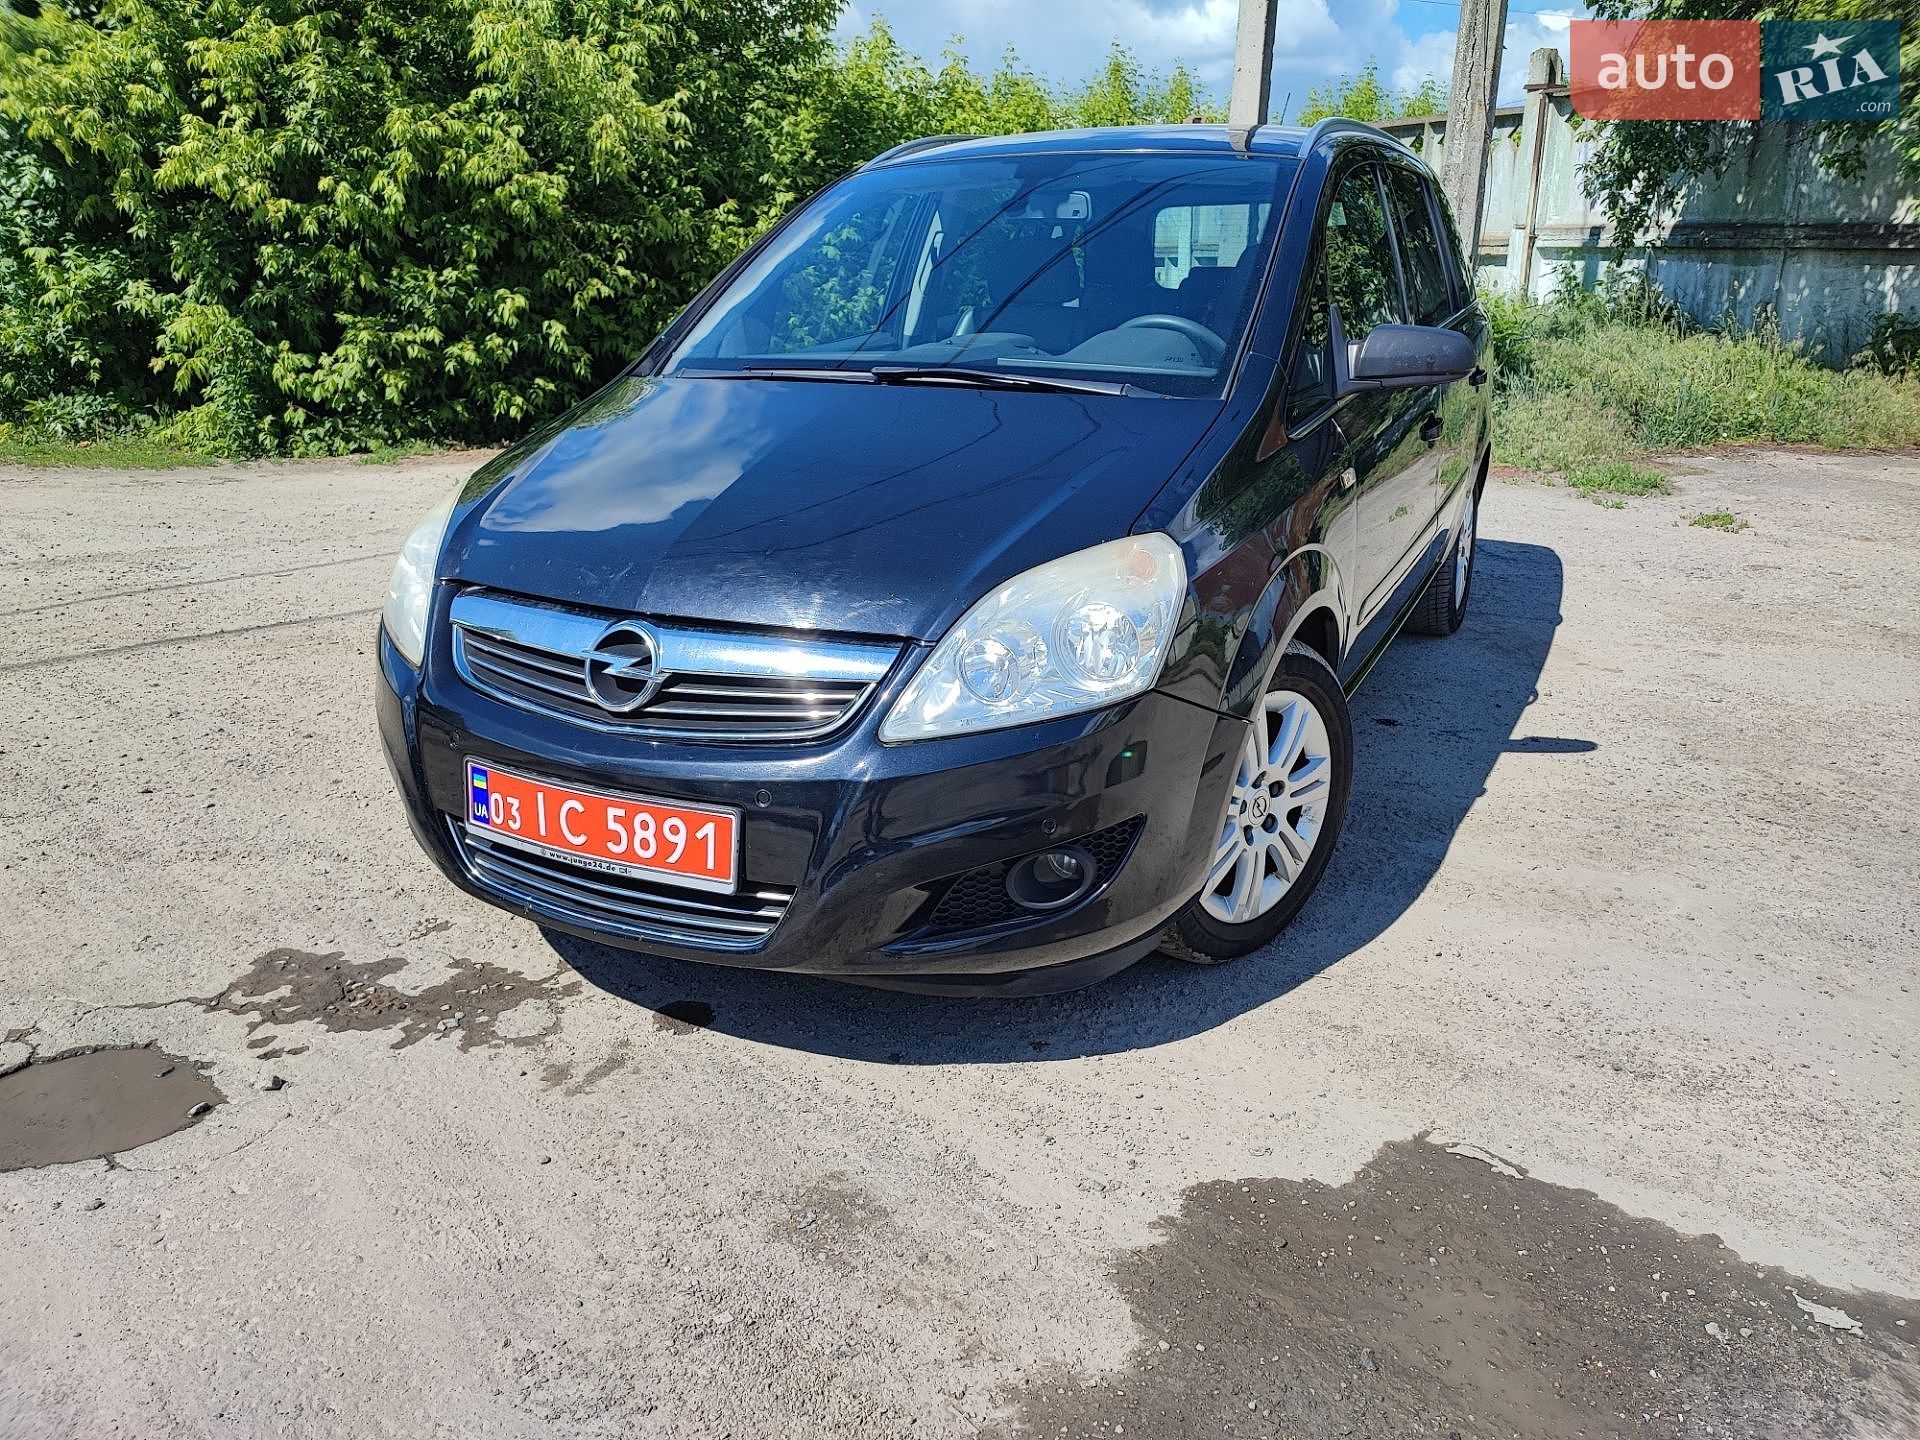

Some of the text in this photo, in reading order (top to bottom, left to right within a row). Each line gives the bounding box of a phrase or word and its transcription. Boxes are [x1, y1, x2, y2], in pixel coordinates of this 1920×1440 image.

[474, 803, 488, 818] UA
[490, 792, 522, 831] 03
[606, 806, 716, 870] 5891
[549, 851, 616, 872] www.junge24.de
